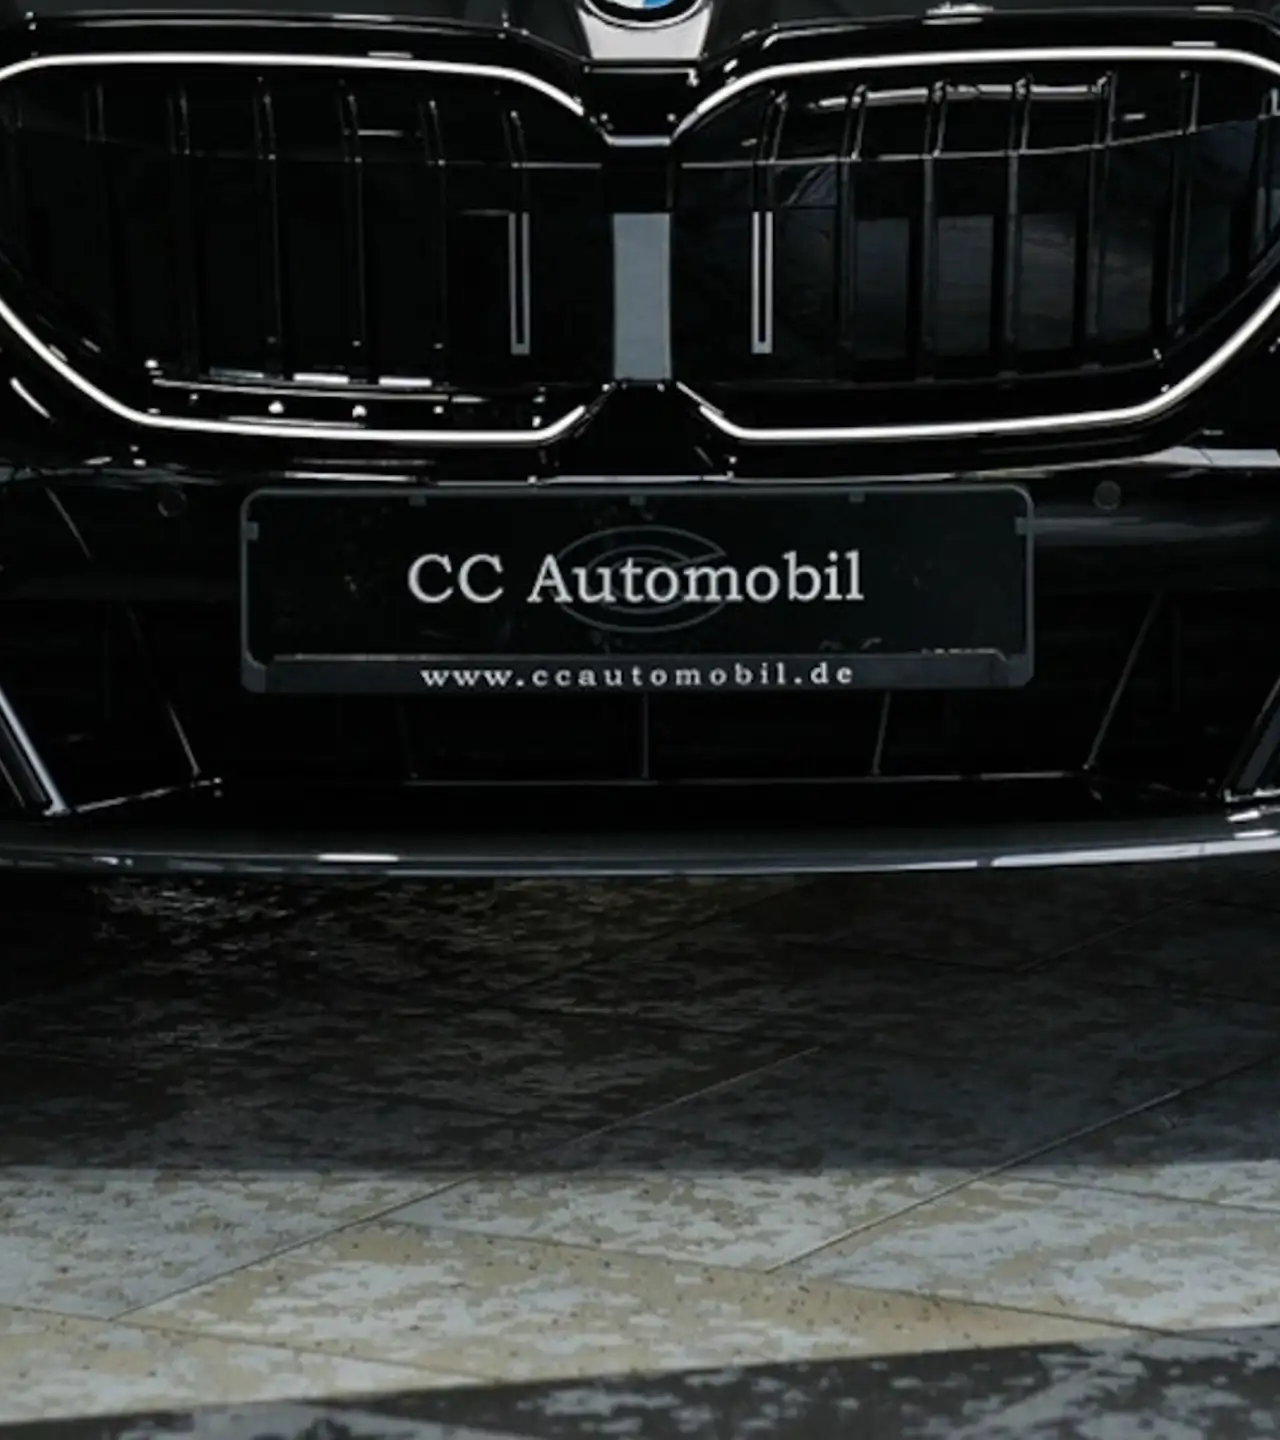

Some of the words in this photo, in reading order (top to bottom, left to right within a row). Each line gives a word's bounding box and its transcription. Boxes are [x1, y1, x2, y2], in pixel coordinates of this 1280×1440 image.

[408, 553, 504, 604] CC
[526, 550, 864, 604] Automobil
[420, 661, 853, 687] www.ccautomobil.de
